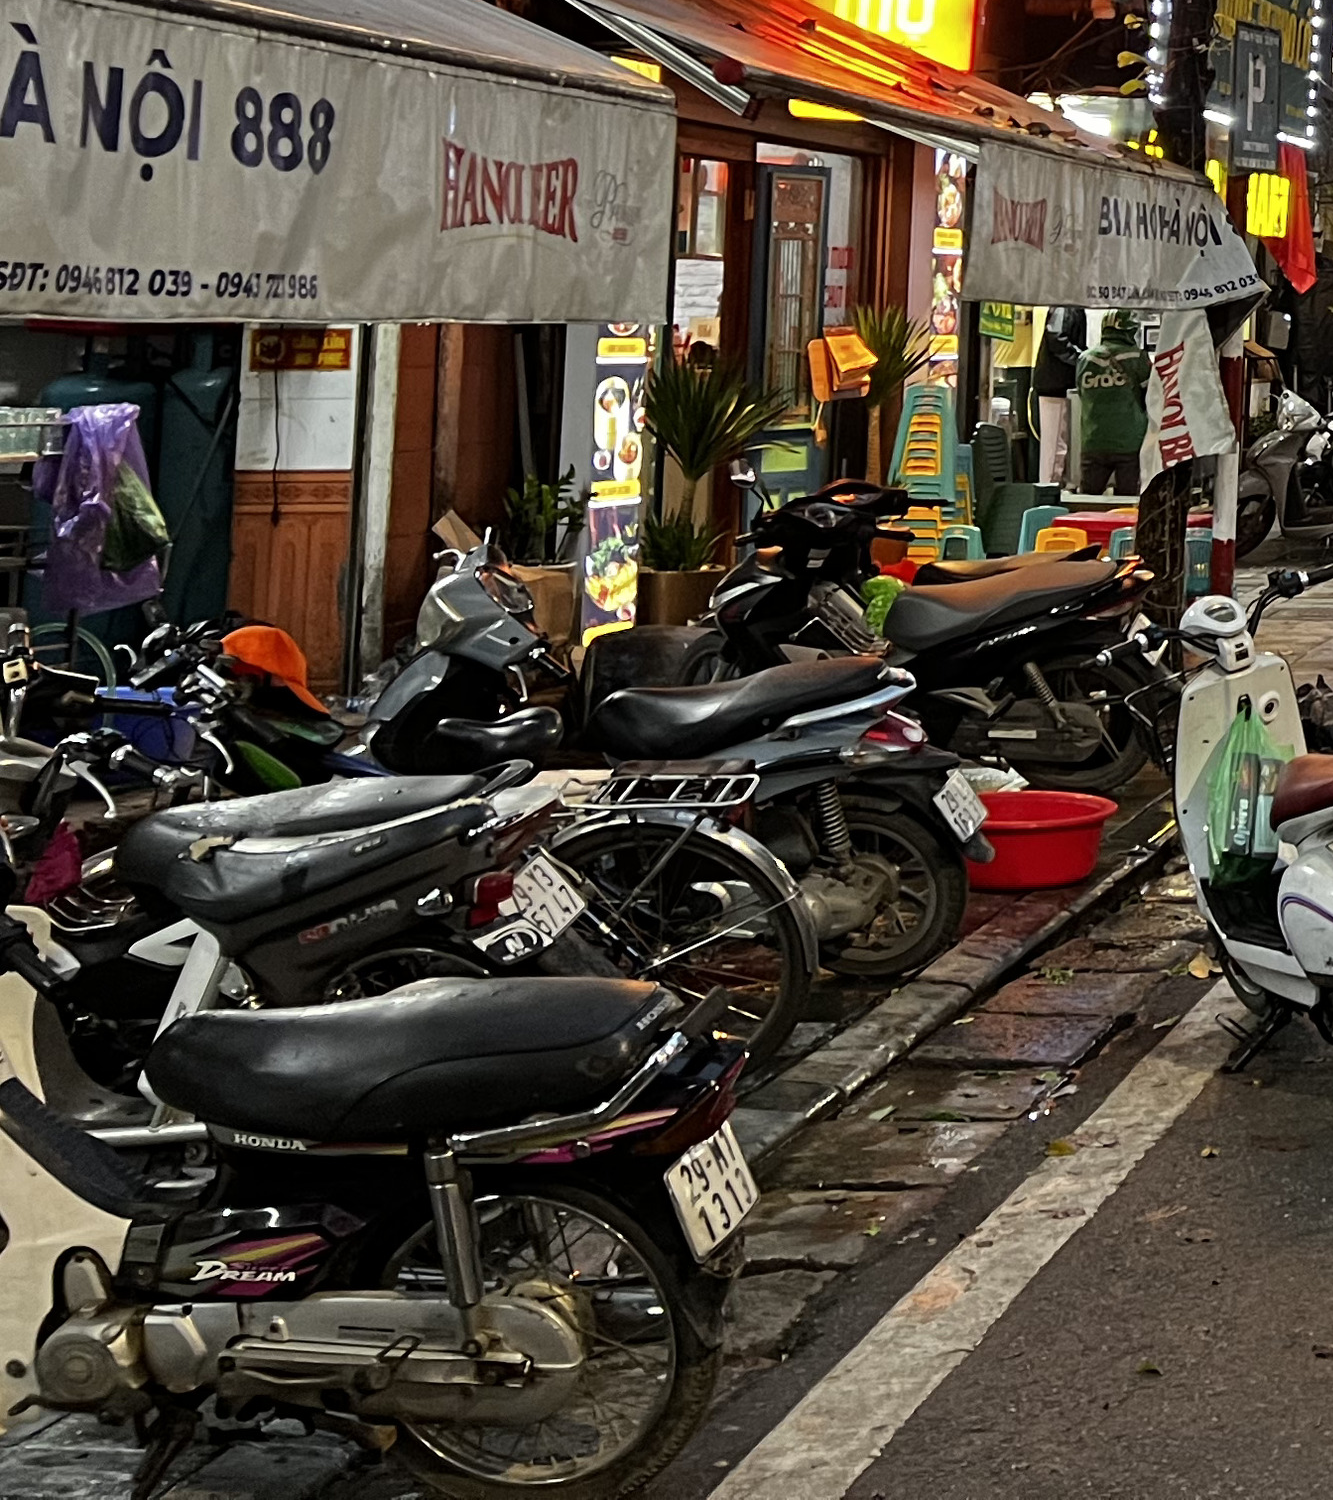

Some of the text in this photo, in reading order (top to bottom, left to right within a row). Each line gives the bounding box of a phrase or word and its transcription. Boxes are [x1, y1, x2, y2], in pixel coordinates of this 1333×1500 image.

[80, 48, 203, 182] NỘI
[230, 86, 336, 175] 888
[147, 269, 192, 297] 039
[1154, 340, 1188, 430] HANOI
[233, 1133, 307, 1151] HONDA
